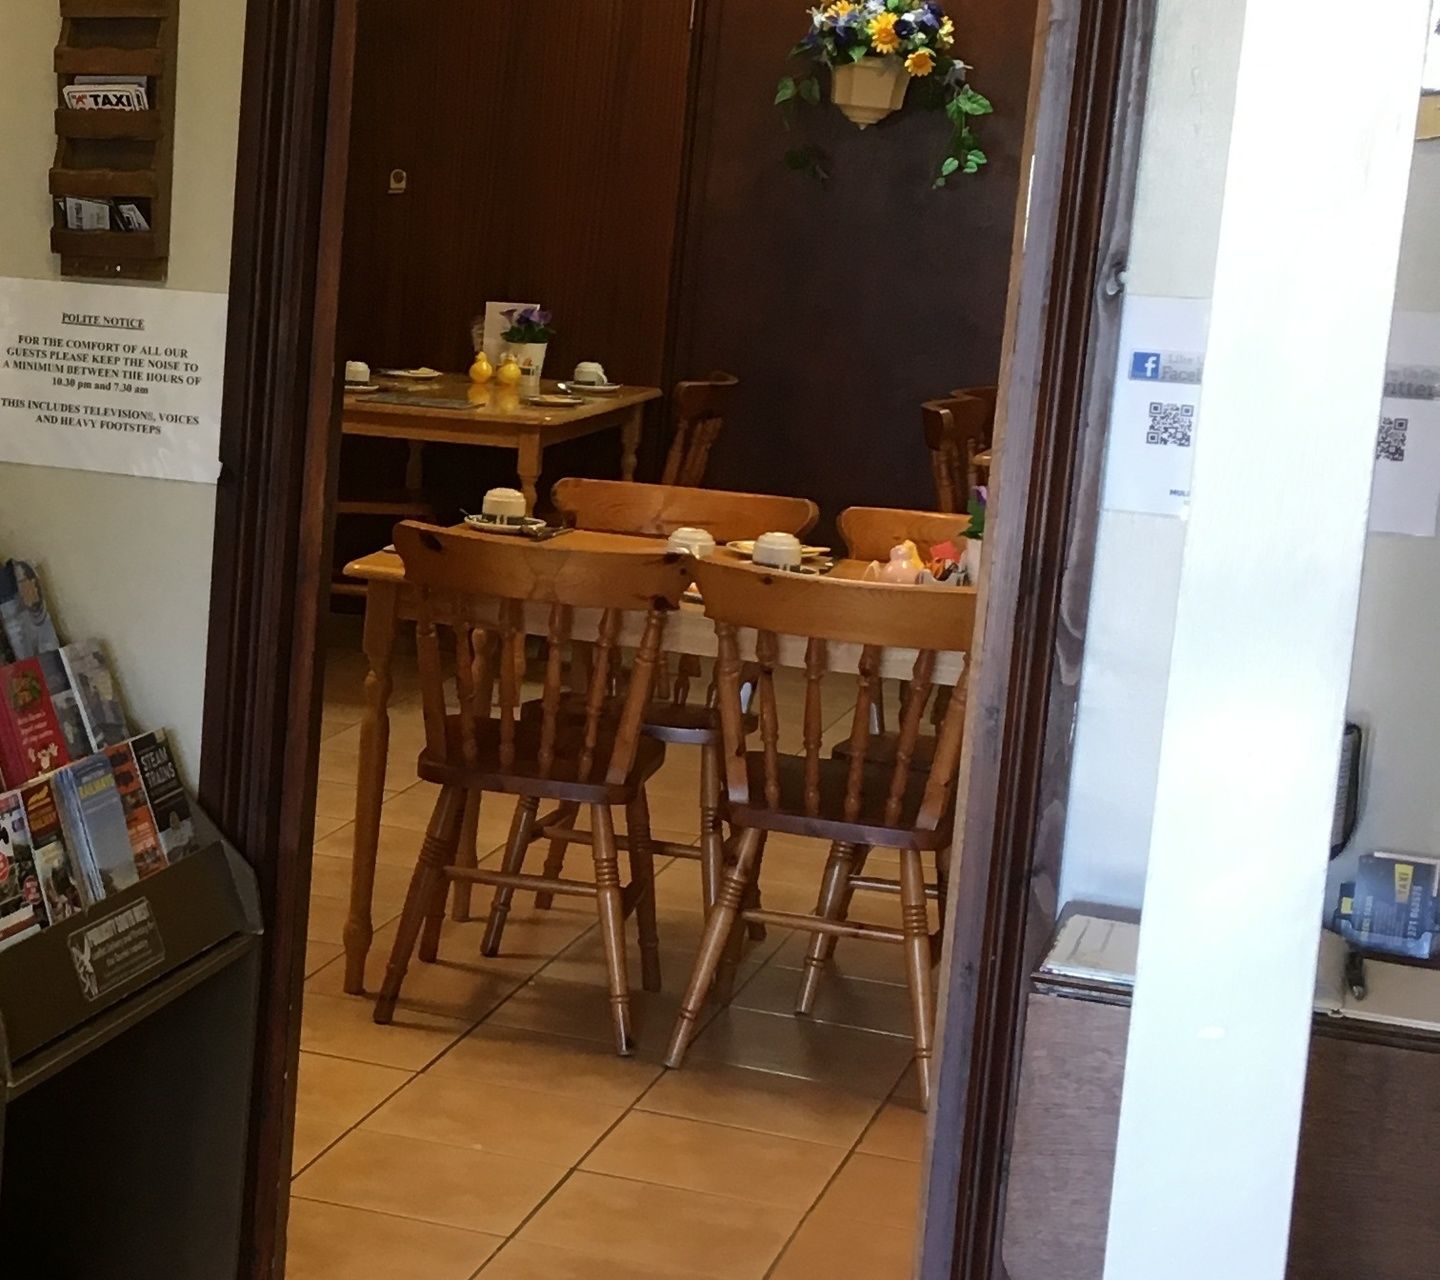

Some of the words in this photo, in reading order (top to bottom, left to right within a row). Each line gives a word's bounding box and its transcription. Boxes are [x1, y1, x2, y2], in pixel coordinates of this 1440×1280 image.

[89, 93, 132, 107] TAXI
[61, 312, 100, 325] POLITE
[103, 316, 145, 329] NOTICE
[18, 334, 40, 345] FOR
[43, 336, 63, 347] THE
[66, 339, 120, 352] COMFORT
[122, 343, 138, 353] OF
[139, 345, 161, 356] ALL
[164, 347, 188, 358] OUR
[7, 347, 47, 358] GUESTS
[50, 351, 89, 363] PLEASE
[92, 354, 121, 365] KEEP
[123, 357, 145, 368] THE
[148, 359, 180, 371] NOISE
[184, 362, 199, 372] TO
[2, 360, 10, 369] A
[13, 361, 64, 374] MINIMUM
[66, 365, 119, 378] BETWEEN
[122, 369, 143, 380] THE
[146, 372, 184, 385] HOURS
[186, 376, 201, 386] OF
[52, 377, 75, 388] 10.30
[77, 381, 92, 390] pm
[95, 381, 111, 391] and
[114, 383, 132, 393] 7.30
[134, 386, 149, 394] am
[1, 398, 25, 409] THIS
[28, 400, 80, 414] INCLUDES
[83, 405, 156, 422] TELEVISIONS,
[159, 413, 200, 425] VOICES
[35, 415, 58, 425] AND
[61, 416, 97, 429] HEAVY
[100, 420, 162, 435] FOOTSTEPS
[140, 747, 168, 771] STEAM
